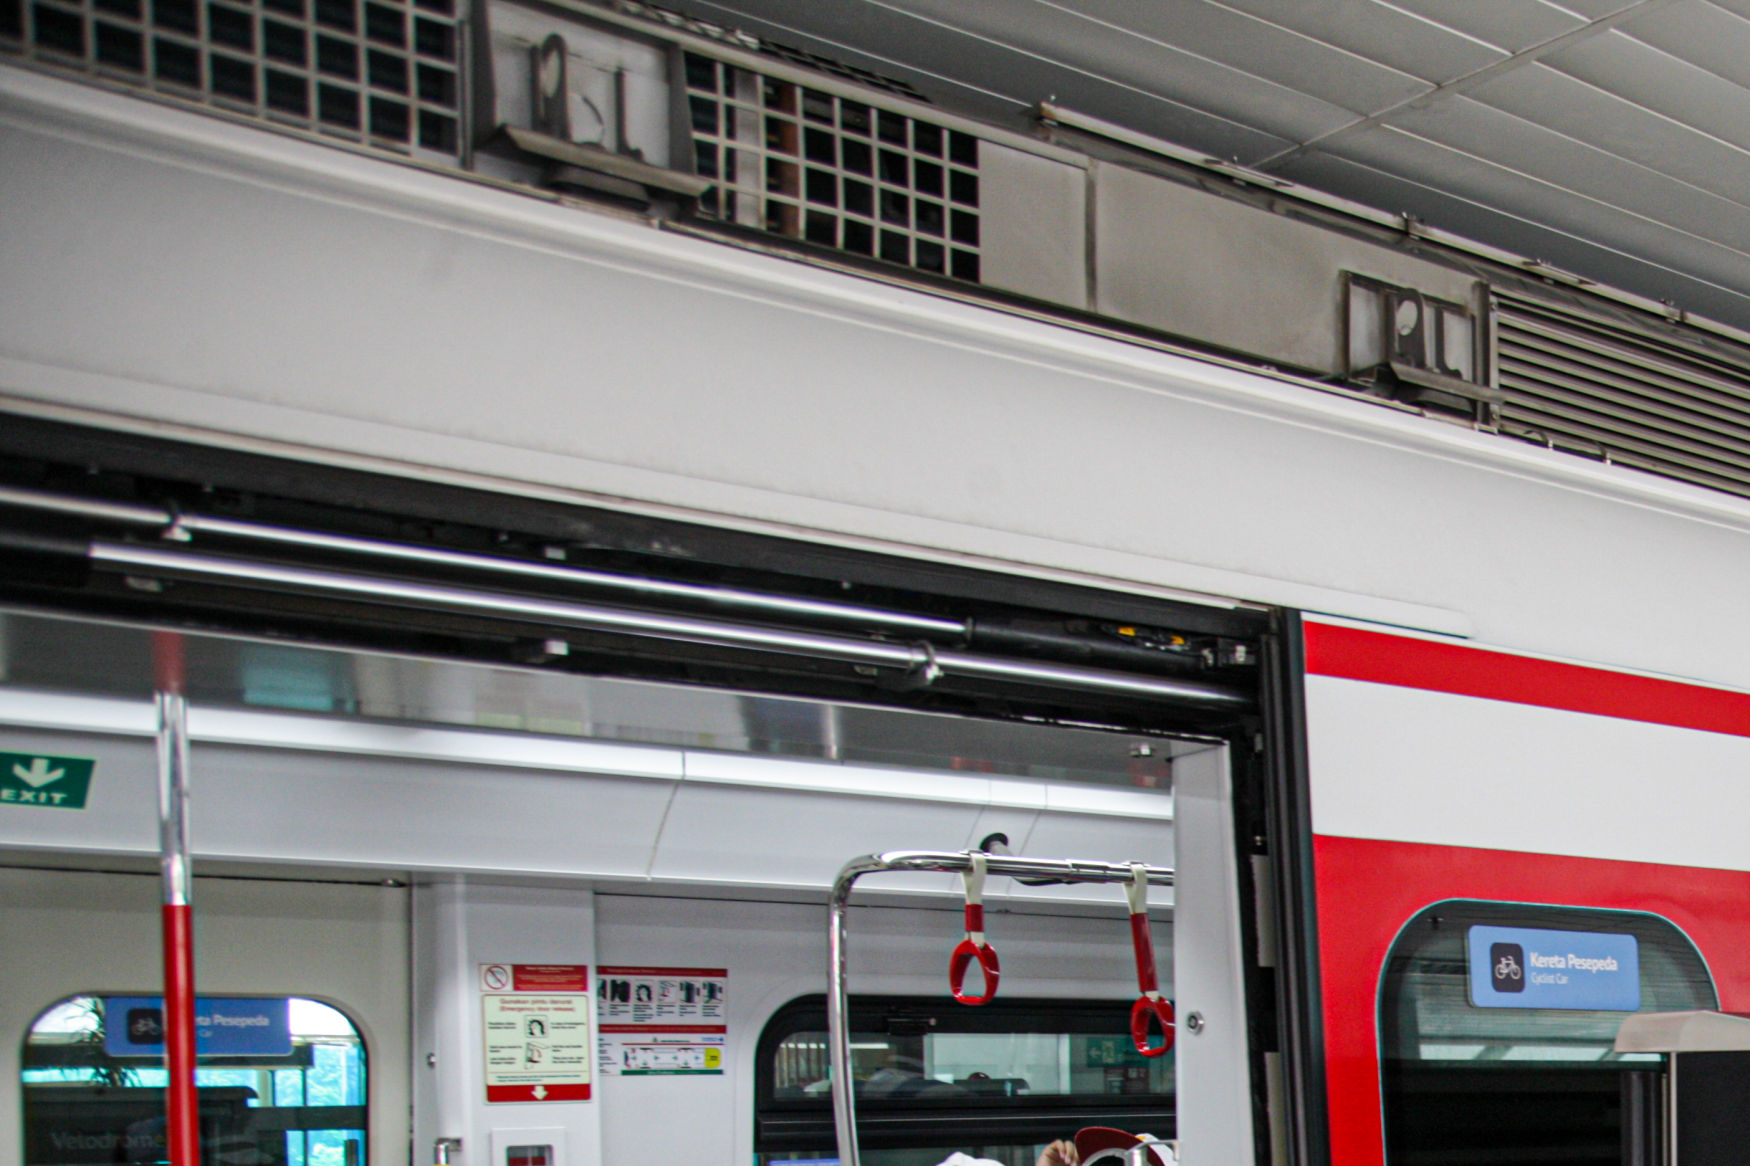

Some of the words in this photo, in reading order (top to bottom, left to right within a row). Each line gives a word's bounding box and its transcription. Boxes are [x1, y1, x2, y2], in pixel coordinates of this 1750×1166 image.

[2, 788, 67, 805] EXIT
[1529, 952, 1566, 968] Kereta
[1568, 953, 1618, 973] Pesepeda
[1531, 972, 1554, 985] Cyclist
[1556, 973, 1568, 984] Car
[213, 1014, 269, 1028] Pesepeda
